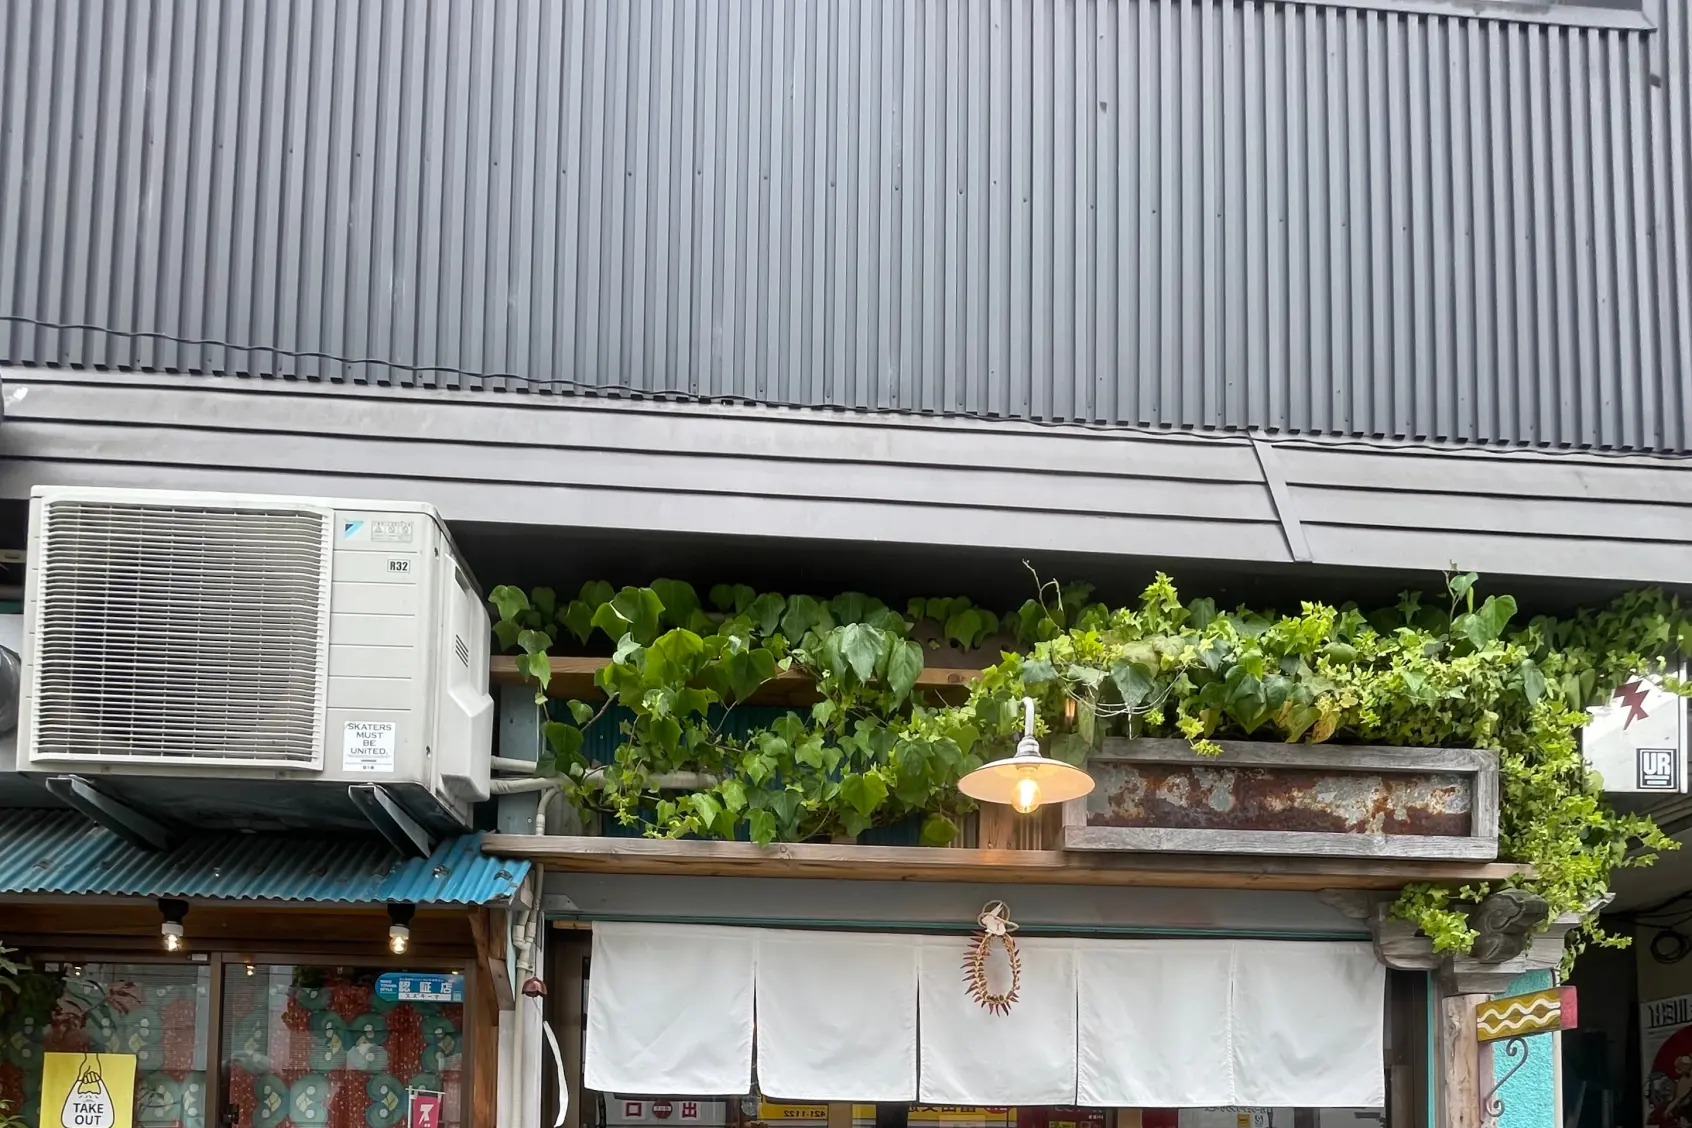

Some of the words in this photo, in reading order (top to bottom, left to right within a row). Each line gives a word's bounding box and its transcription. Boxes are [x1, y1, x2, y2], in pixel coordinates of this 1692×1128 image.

[389, 561, 409, 571] R32
[348, 723, 392, 731] SKATERS
[356, 731, 384, 739] MUST
[362, 739, 377, 747] BE
[350, 747, 389, 755] UNITED.
[1642, 751, 1671, 775] UR
[73, 1103, 104, 1114] TAKE
[74, 1115, 102, 1125] OUT
